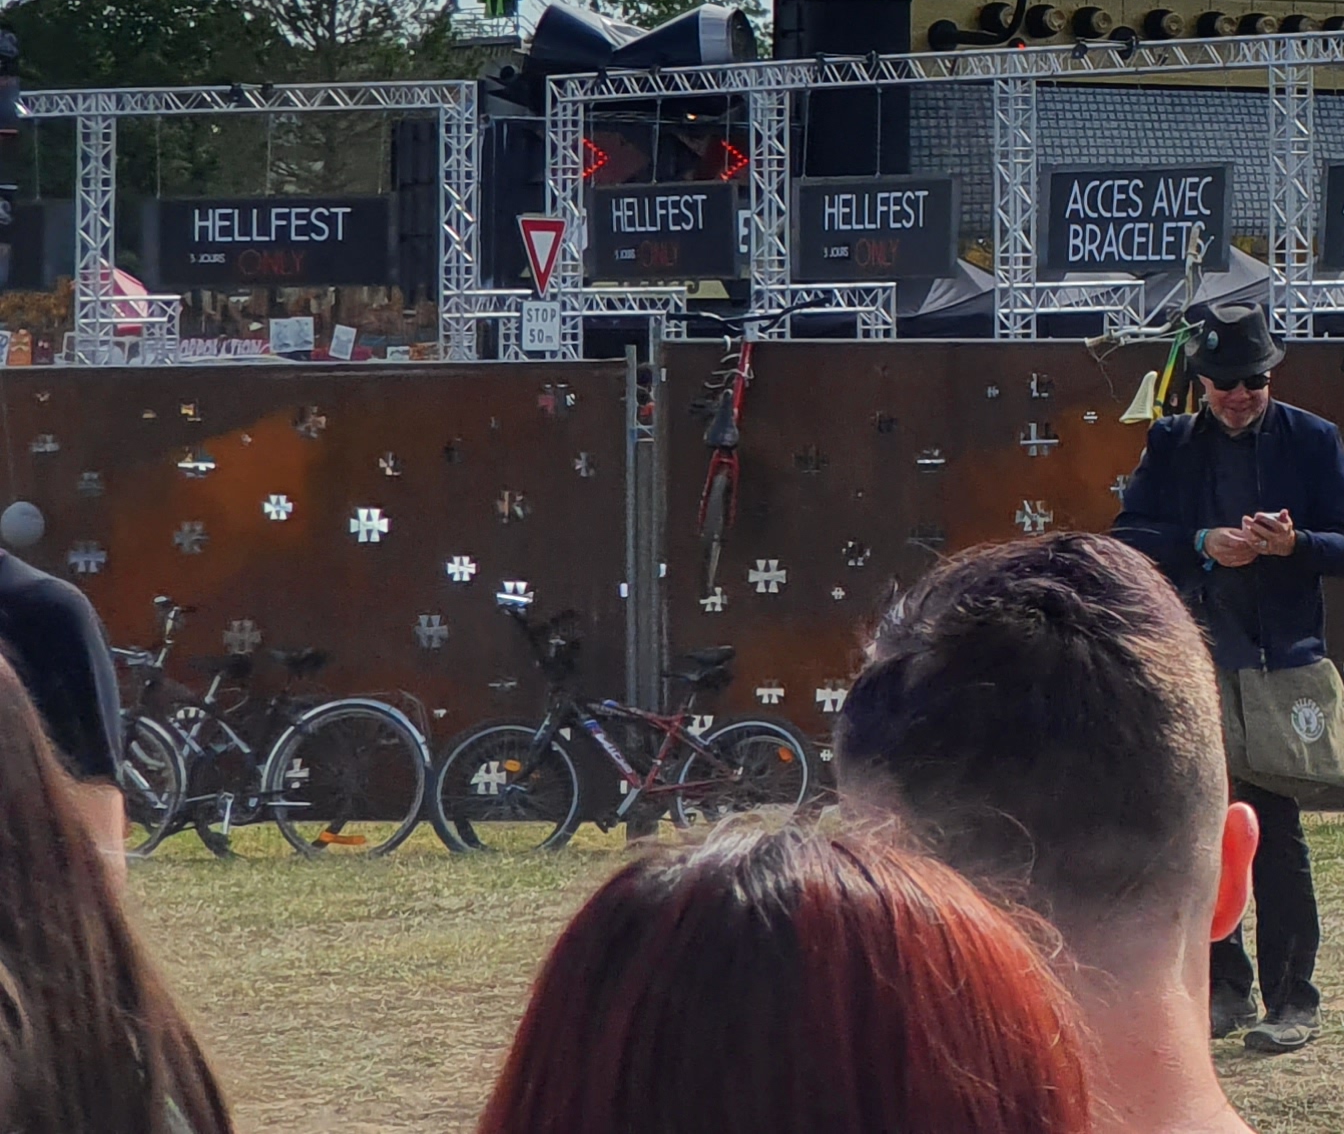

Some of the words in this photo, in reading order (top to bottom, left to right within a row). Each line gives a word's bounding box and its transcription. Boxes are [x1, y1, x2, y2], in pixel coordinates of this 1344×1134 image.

[612, 195, 707, 232] HELLFEST
[824, 190, 929, 230] HELLFEST
[1065, 178, 1144, 218] ACCES
[1152, 176, 1213, 218] AVEC
[194, 207, 352, 242] HELLFEST
[238, 249, 306, 275] ONLY
[854, 238, 900, 267] ONLY
[527, 307, 556, 323] STOP
